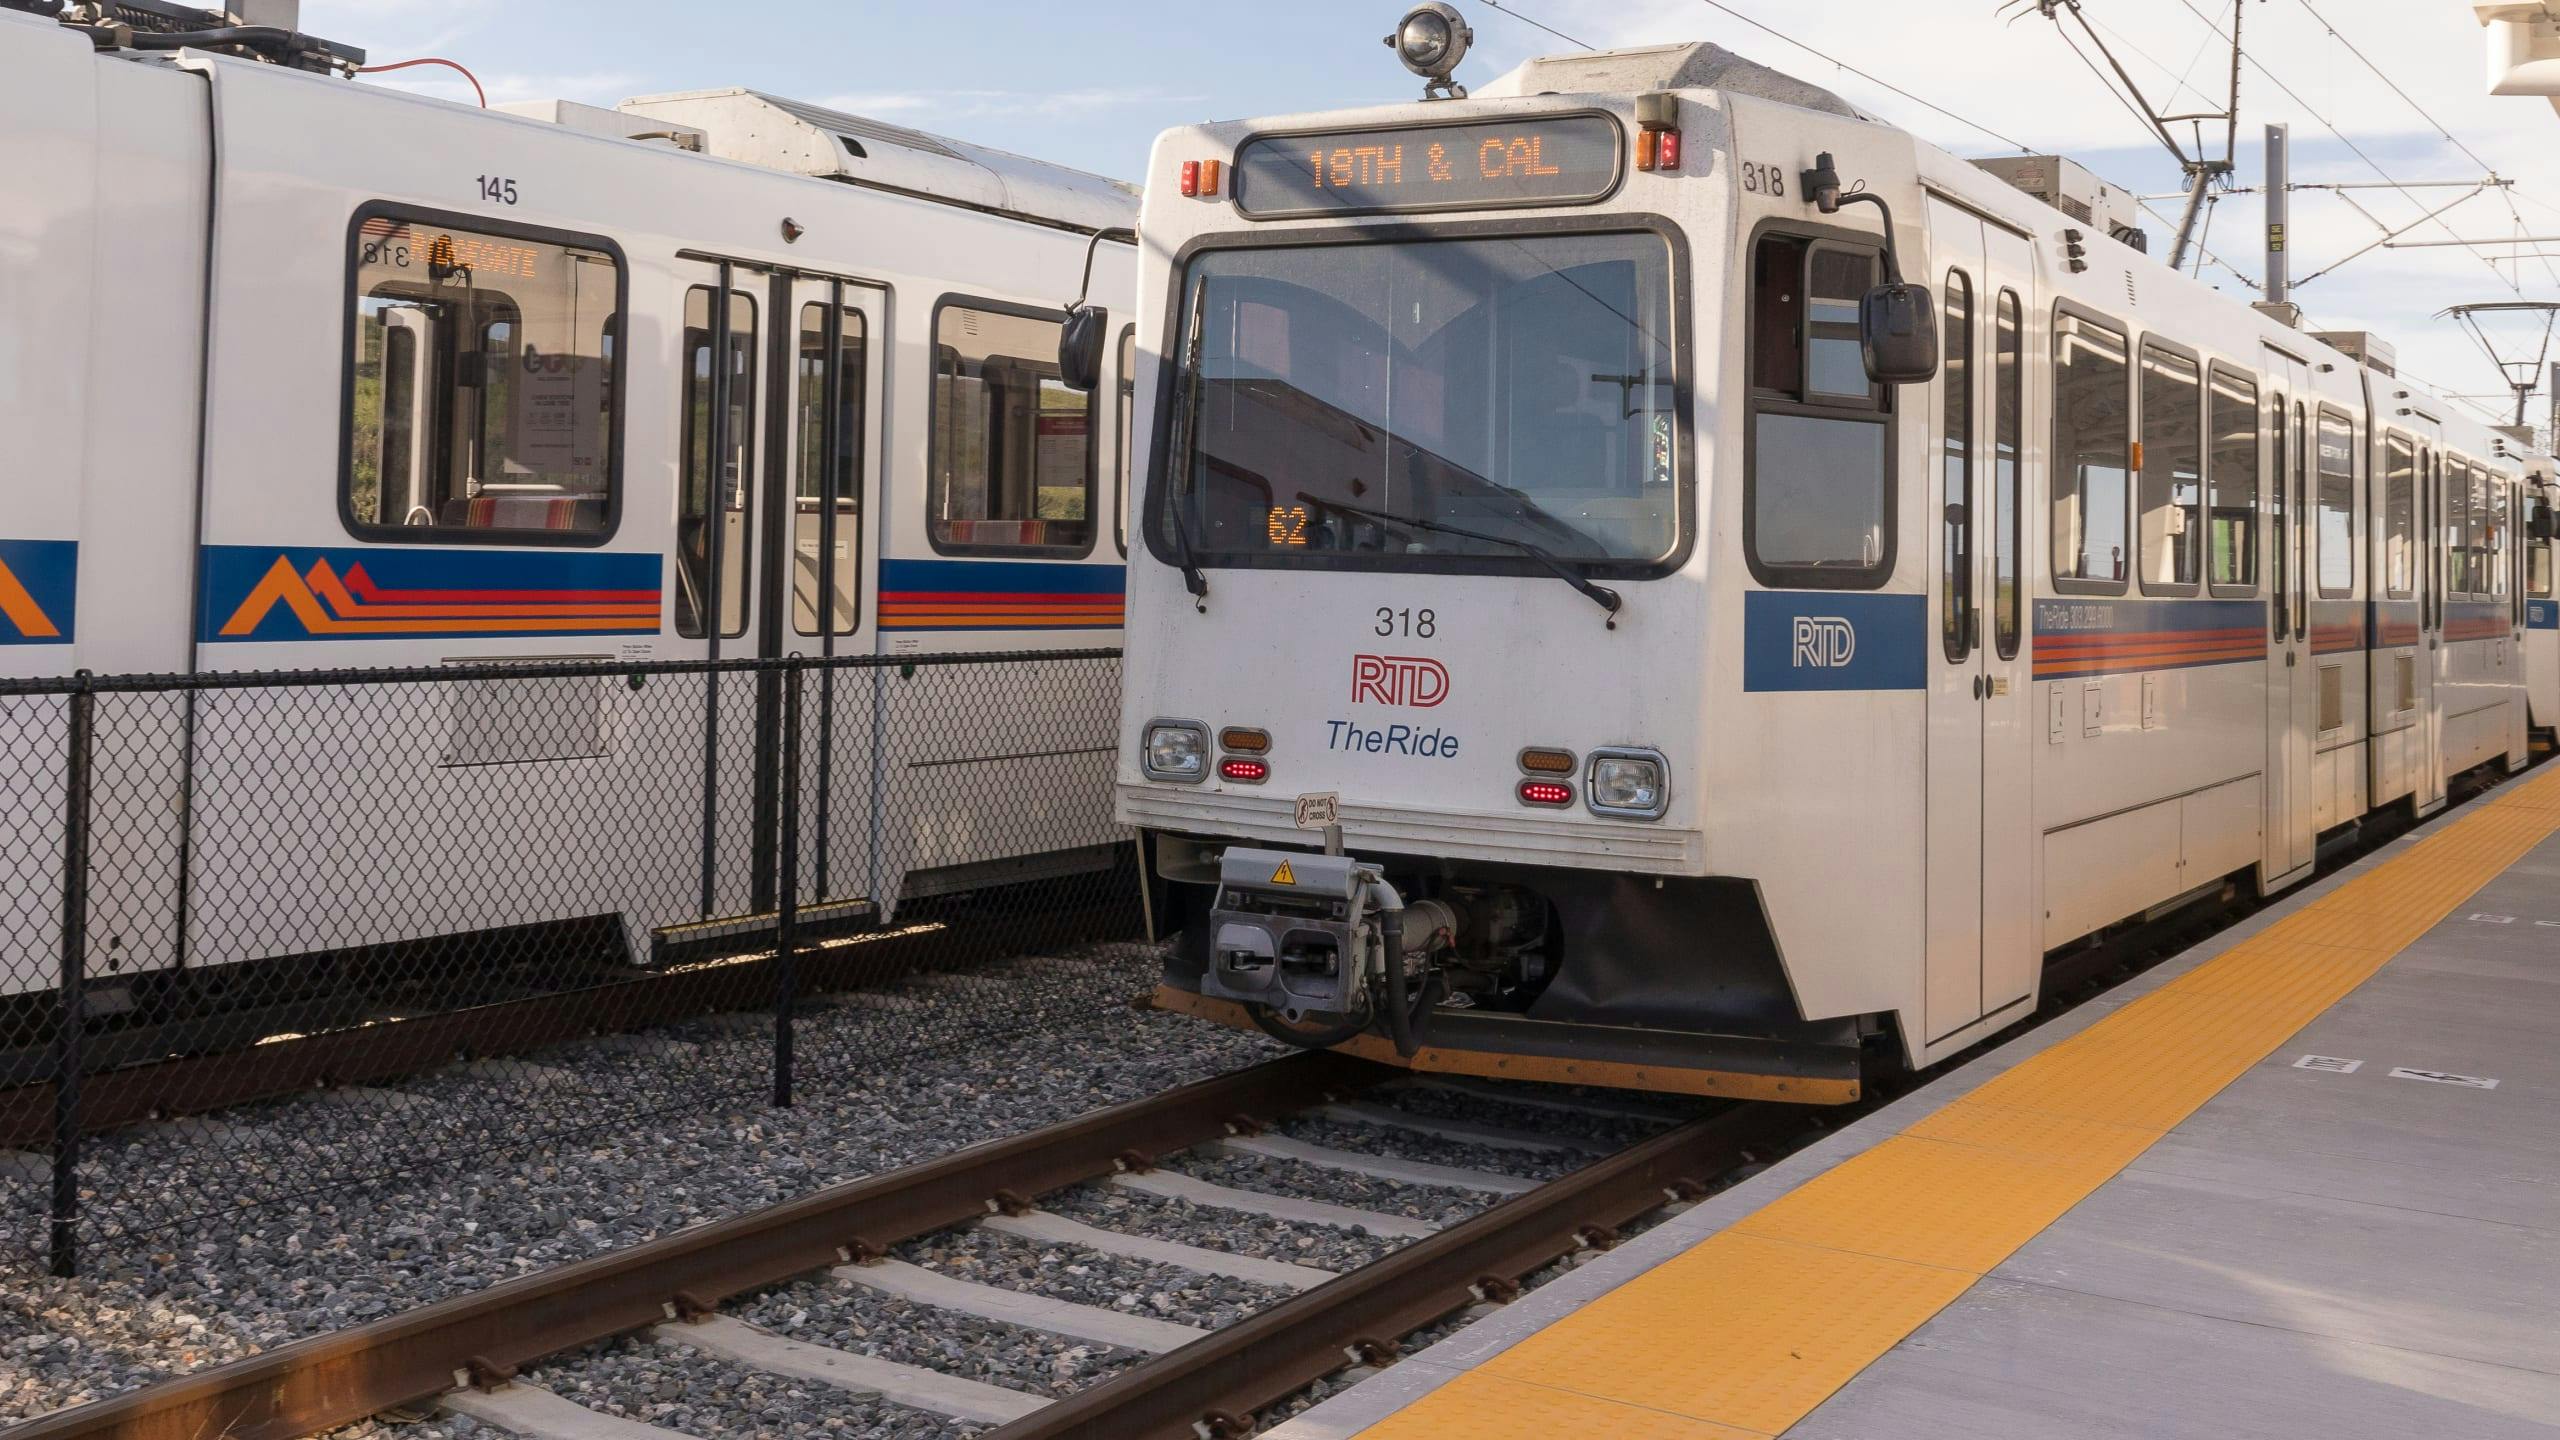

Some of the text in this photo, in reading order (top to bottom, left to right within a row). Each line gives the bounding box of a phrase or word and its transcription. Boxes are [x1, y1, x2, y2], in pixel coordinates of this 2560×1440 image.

[1310, 136, 1559, 188] 18TH & CAL
[1743, 161, 1784, 197] 318
[476, 174, 518, 205] 145
[1269, 507, 1306, 544] 62
[1375, 607, 1435, 638] 318
[1793, 616, 1856, 667] RTD
[1351, 654, 1450, 707] RTD
[1327, 720, 1459, 758] TheRide
[1309, 798, 1327, 808] DO NOT
[1309, 811, 1326, 821] CROSS
